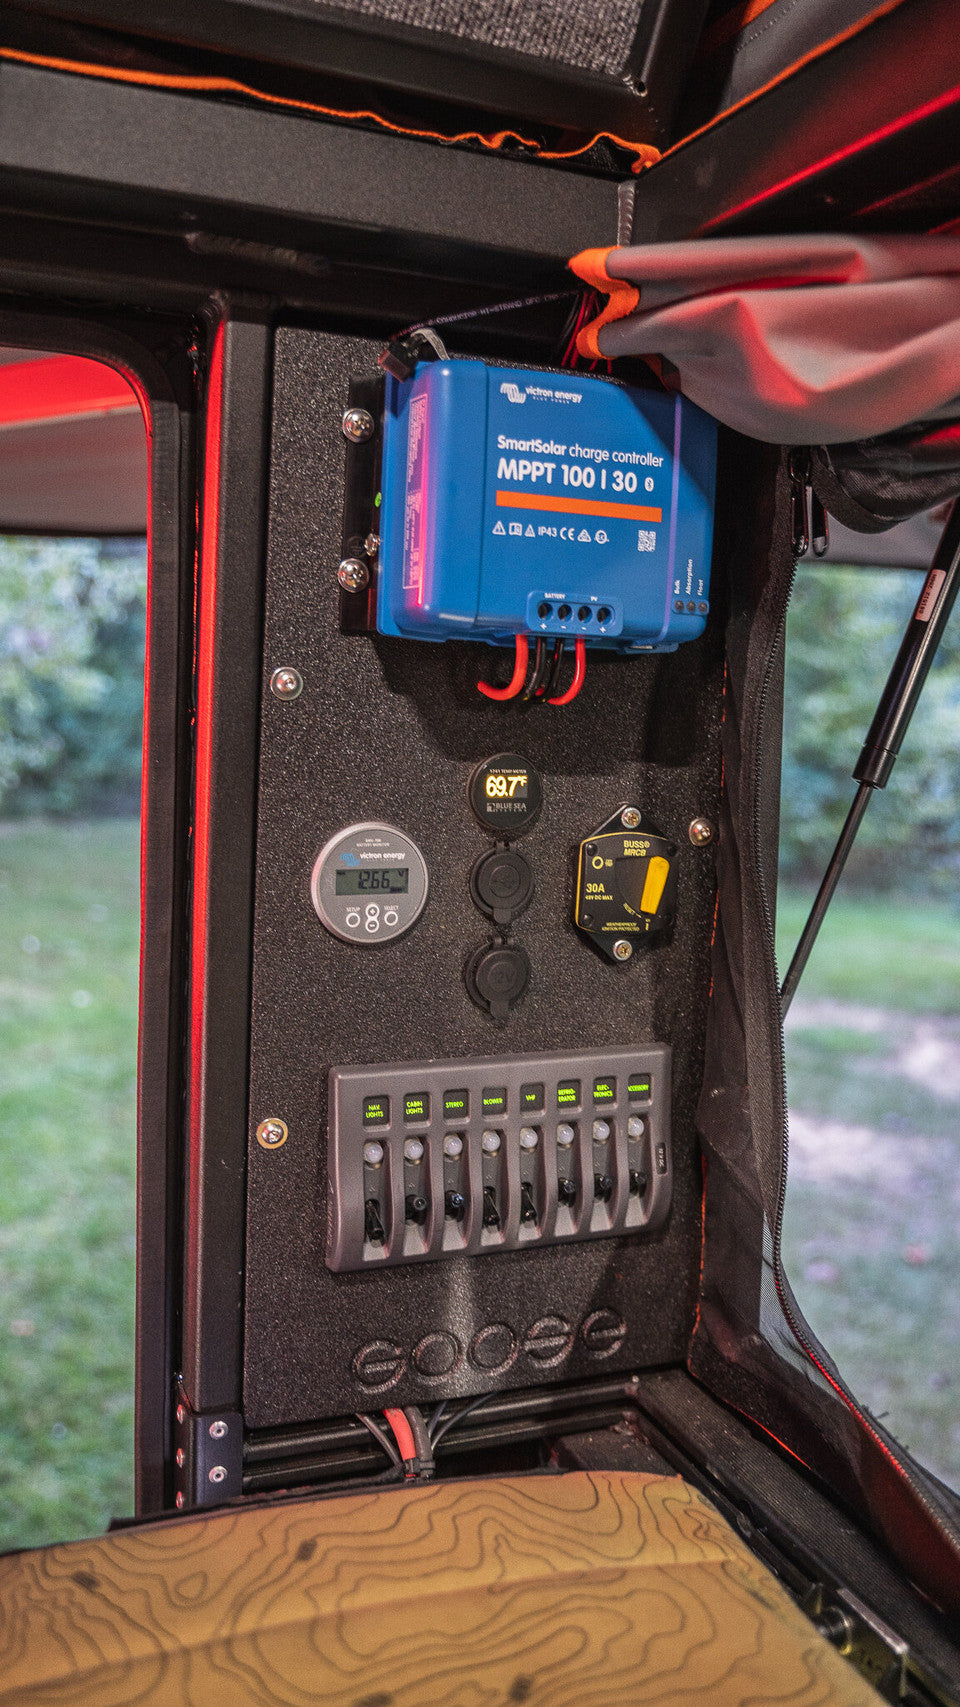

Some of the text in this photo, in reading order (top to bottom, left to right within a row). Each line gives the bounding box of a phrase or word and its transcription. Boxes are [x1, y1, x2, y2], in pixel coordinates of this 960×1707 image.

[525, 385, 583, 404] victron energy
[497, 434, 664, 468] SmartSolar charge controller
[497, 457, 556, 484] MPPT
[561, 464, 596, 489] 100
[612, 470, 638, 493] 30
[538, 525, 558, 538] IP43
[685, 558, 694, 595] Absorption
[673, 579, 681, 595] Bulk
[360, 852, 382, 860] victron
[383, 852, 406, 861] energy
[586, 883, 605, 893] 30A
[406, 1100, 423, 1108] CABIN
[445, 1101, 464, 1109] STEREO
[483, 1097, 503, 1105] BLOWER
